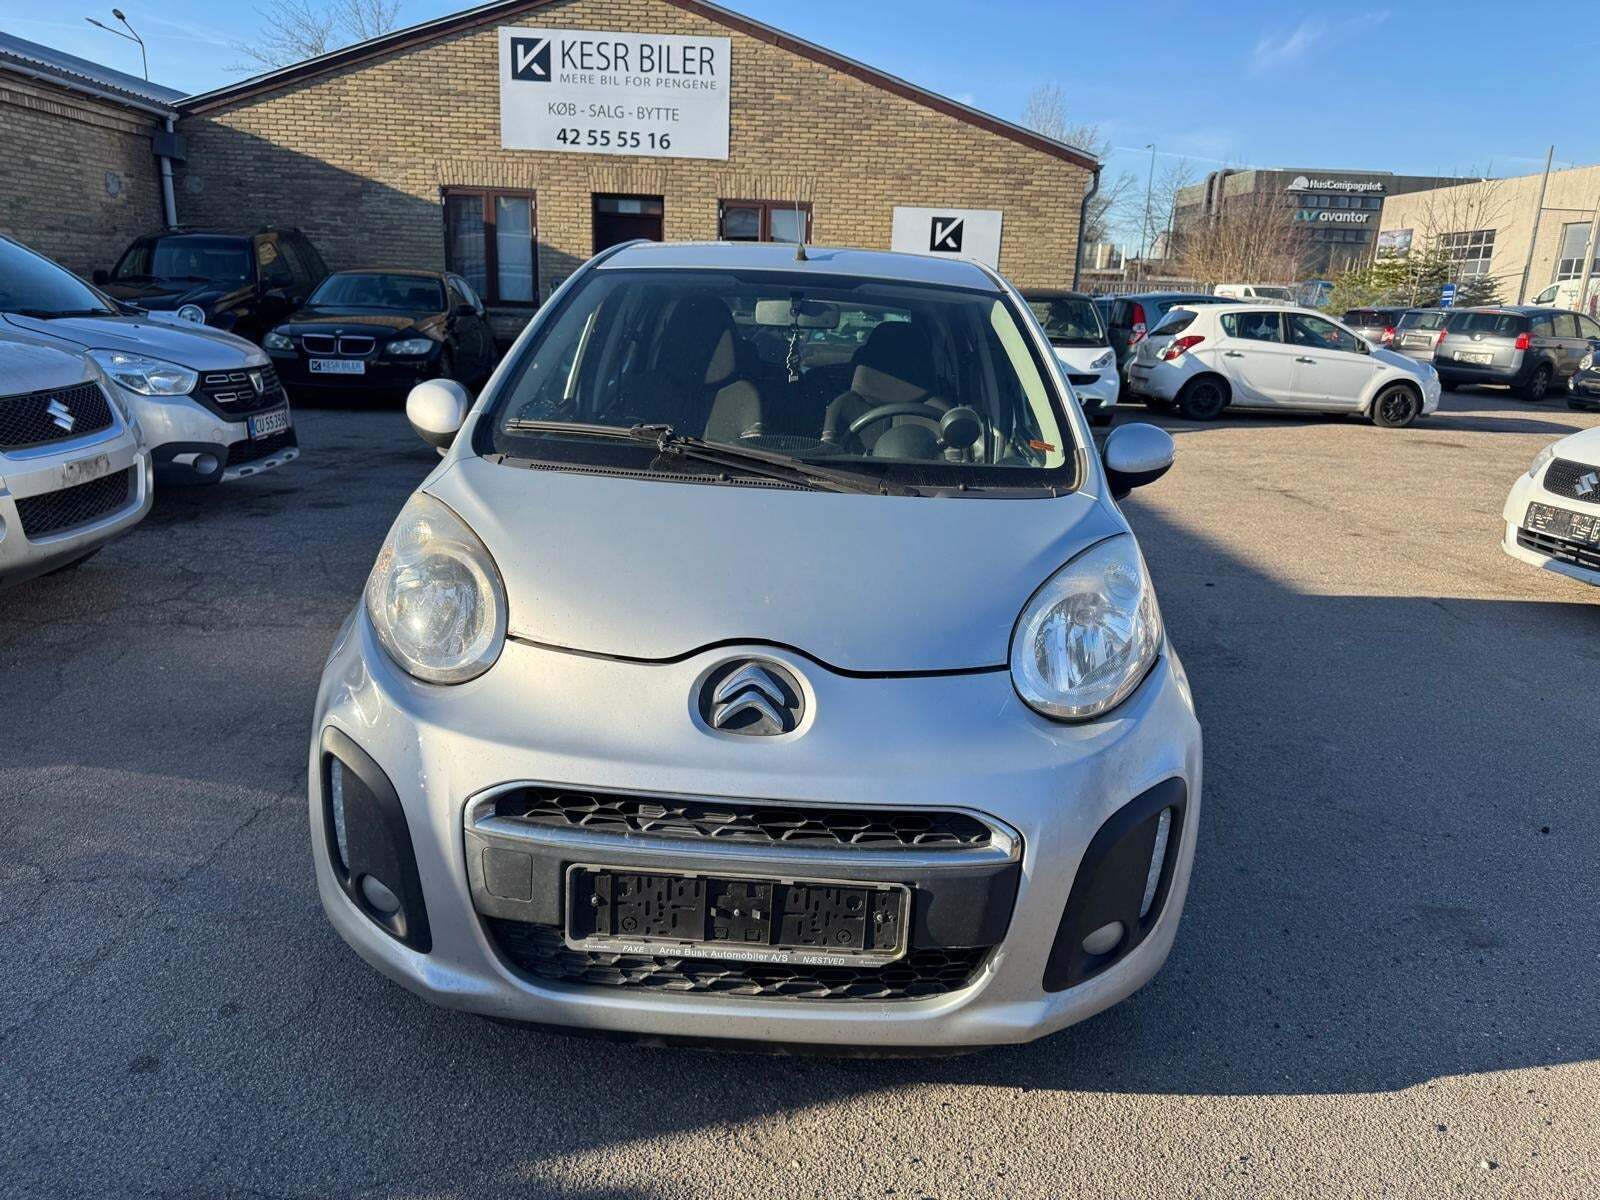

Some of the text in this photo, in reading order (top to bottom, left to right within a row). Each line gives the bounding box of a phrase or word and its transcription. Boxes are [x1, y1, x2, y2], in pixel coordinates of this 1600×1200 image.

[561, 40, 715, 76] KESR BILER
[560, 73, 717, 90] MERE BIL FOR PENGENE
[548, 102, 577, 116] KØB
[589, 104, 624, 119] SALG
[637, 106, 680, 121] BYTTE
[556, 128, 671, 150] 42 55 55 16
[1309, 179, 1383, 192] HusCompagniet
[1320, 211, 1369, 223] avantor
[622, 945, 845, 965] FAXE Arne Busk Automobiler A/S NÆSTVED
